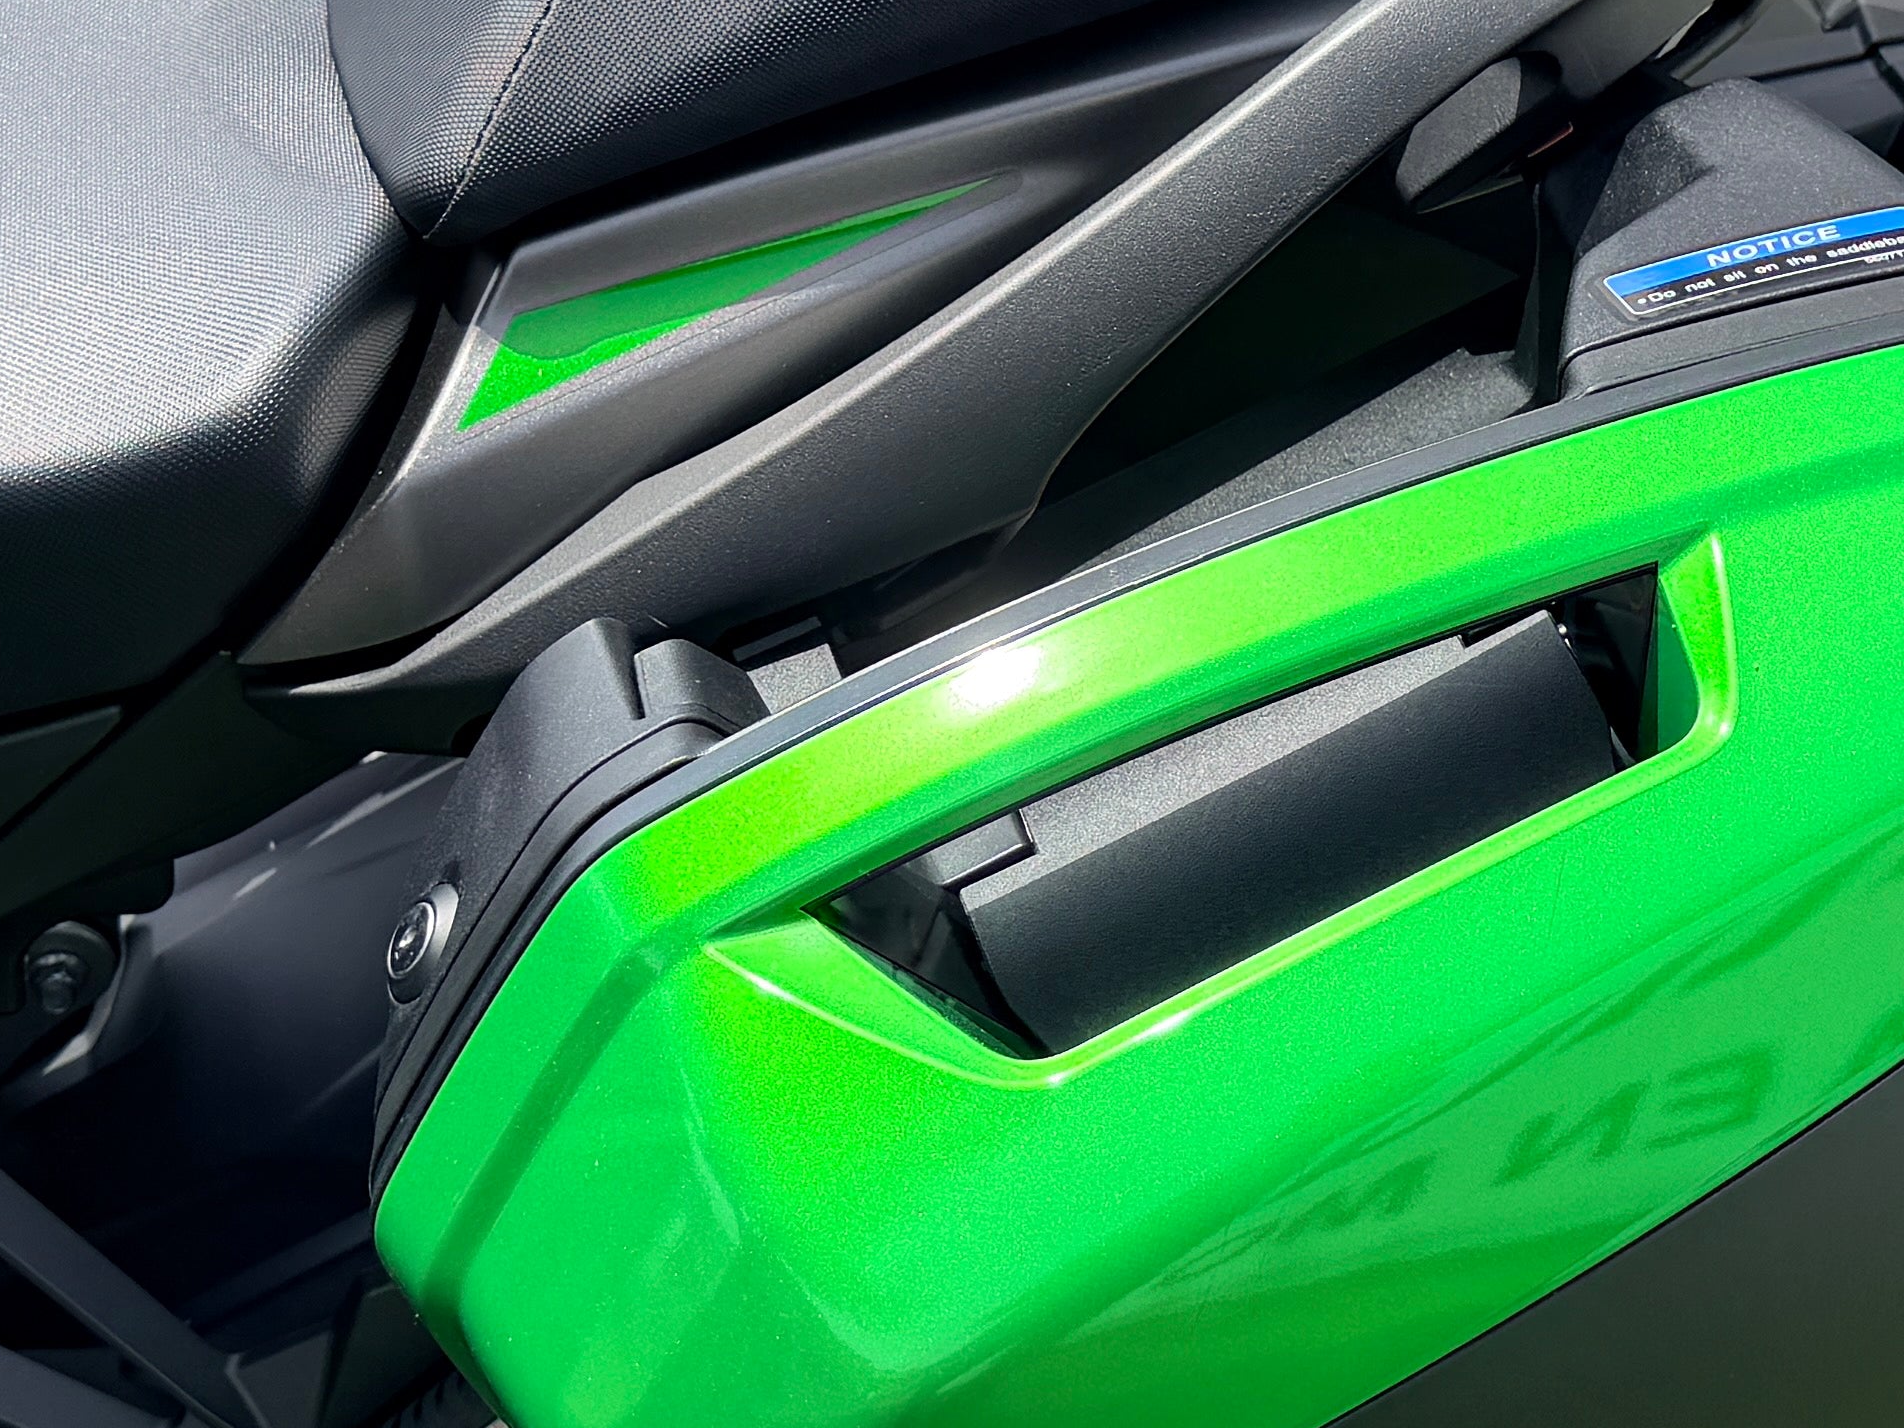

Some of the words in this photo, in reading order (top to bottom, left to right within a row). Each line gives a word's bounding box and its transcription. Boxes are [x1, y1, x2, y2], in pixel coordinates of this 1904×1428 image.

[1706, 224, 1841, 269] NOTICE
[1684, 277, 1716, 295] not
[1723, 268, 1747, 283] sit
[1754, 261, 1780, 274] on
[1785, 250, 1818, 267] the
